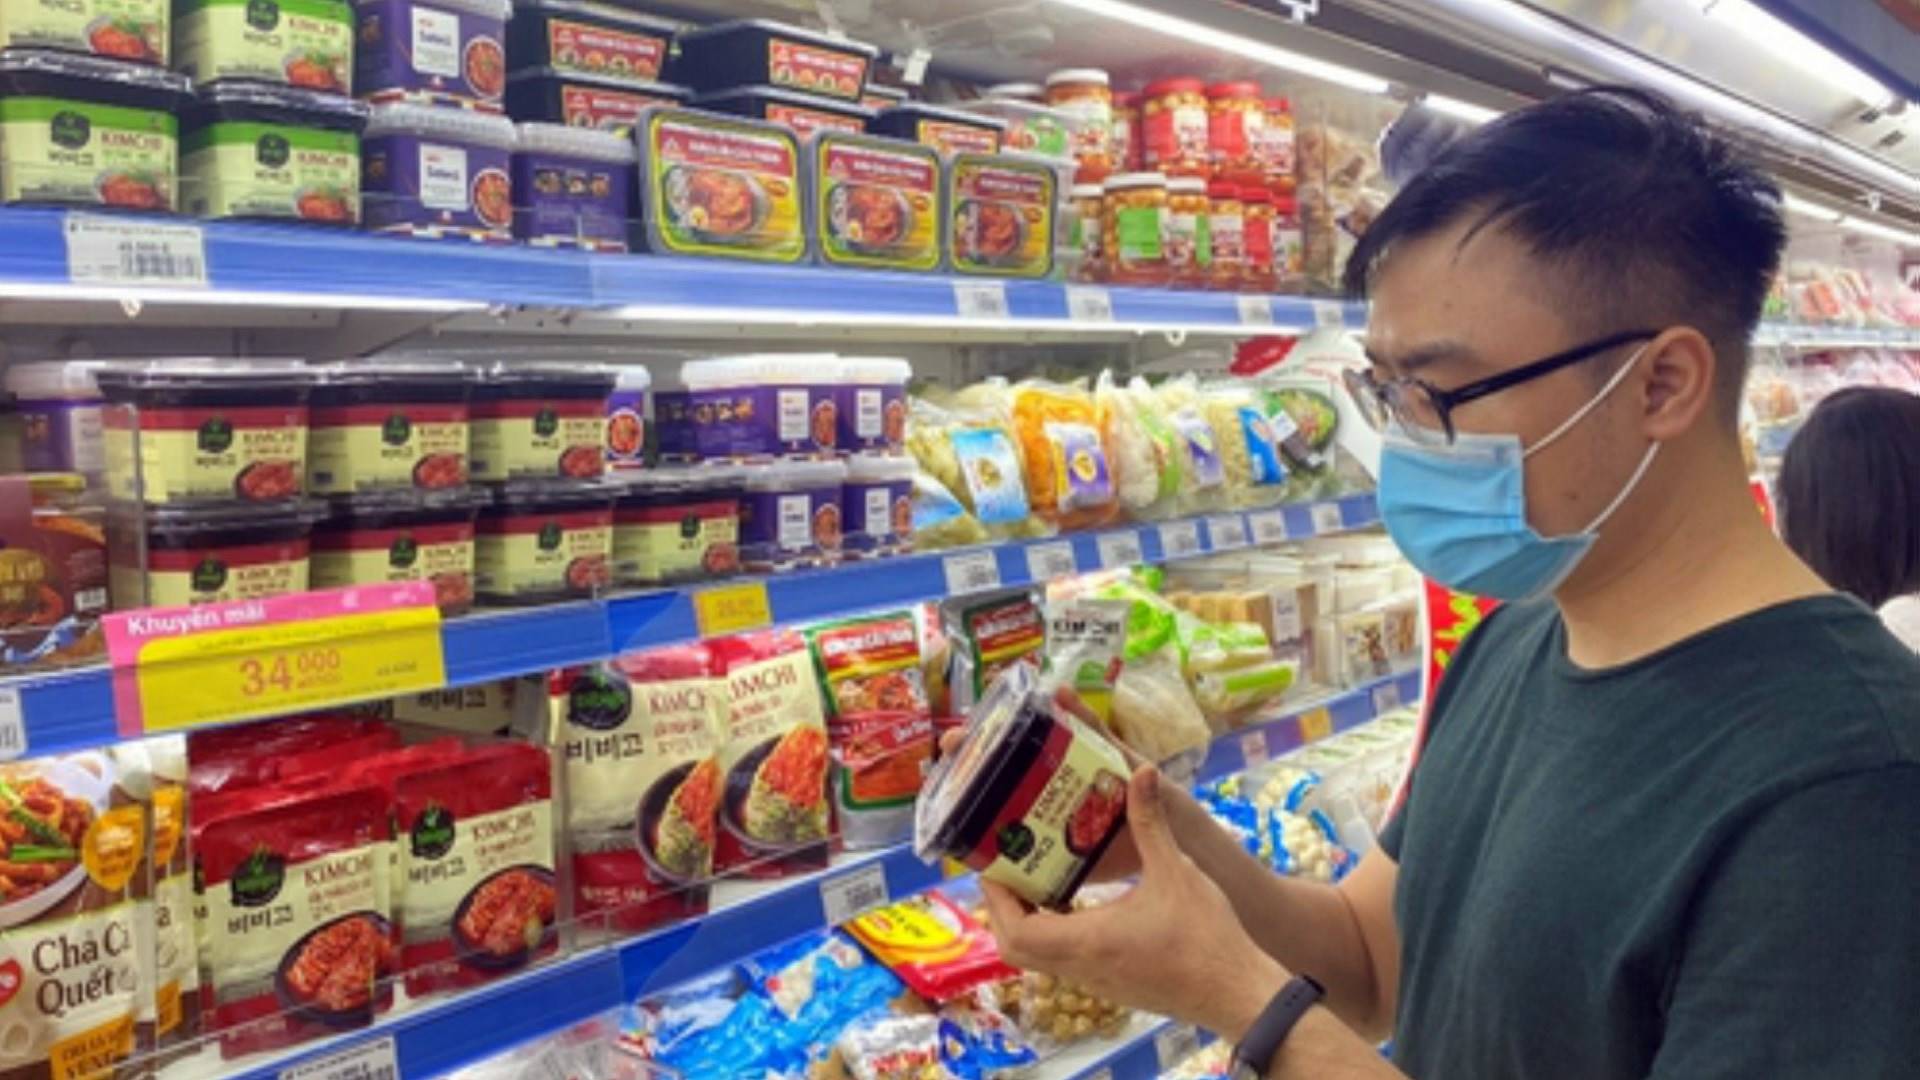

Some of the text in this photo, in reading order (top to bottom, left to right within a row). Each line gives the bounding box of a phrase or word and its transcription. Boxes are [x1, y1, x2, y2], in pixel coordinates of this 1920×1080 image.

[127, 605, 220, 635] Khuyến
[222, 602, 266, 627] mãi
[238, 654, 293, 698] 34
[565, 733, 645, 764] 비비고
[303, 854, 374, 887] KIMCHI
[227, 904, 294, 935] 비비고
[33, 929, 99, 976] Chả
